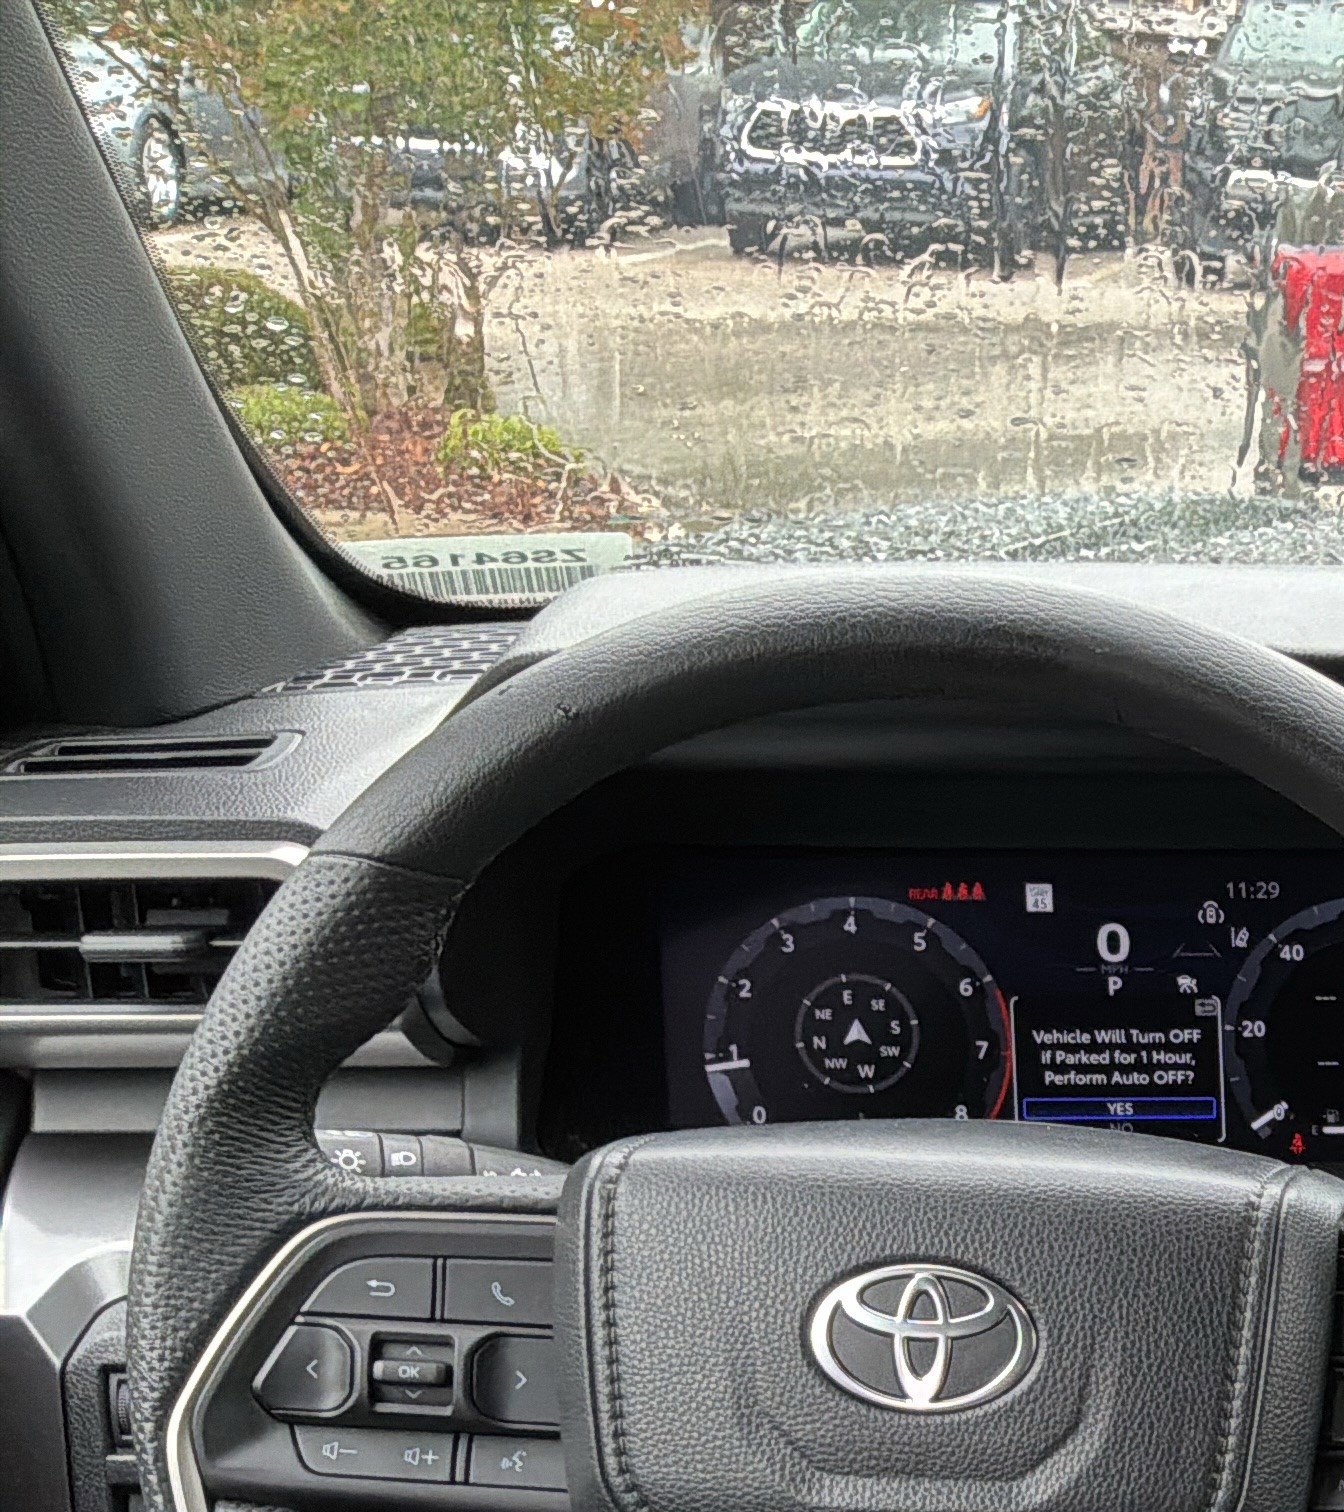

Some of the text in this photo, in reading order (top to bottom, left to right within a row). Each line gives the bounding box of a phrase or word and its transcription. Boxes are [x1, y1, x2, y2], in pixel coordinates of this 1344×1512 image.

[1226, 881, 1280, 899] 11:29
[1032, 896, 1048, 911] 45
[843, 916, 858, 934] 4
[781, 933, 795, 952] 3
[913, 932, 926, 951] 5
[1097, 922, 1130, 963] 0
[1279, 944, 1304, 961] 40
[1101, 965, 1129, 975] MPH
[739, 979, 752, 998] 2
[959, 978, 973, 996] 6
[1108, 976, 1123, 996] P
[842, 990, 852, 1005] E
[870, 999, 886, 1012] SE
[815, 1008, 832, 1021] NE
[890, 1020, 900, 1035] S
[1242, 1020, 1266, 1037] 20
[813, 1036, 826, 1050] N
[1032, 1029, 1202, 1045] Vehicle Will Turn OFF
[728, 1044, 738, 1060] 1
[880, 1045, 900, 1057] SW
[975, 1041, 989, 1060] 7
[1041, 1050, 1196, 1066] If Parked for 1 Hour,
[825, 1058, 847, 1070] NW
[857, 1065, 875, 1078] W
[1045, 1070, 1195, 1087] Perform Auto OFF?
[752, 1105, 766, 1124] 0
[955, 1105, 969, 1120] 8
[1107, 1103, 1134, 1116] YES
[399, 1366, 419, 1379] OK
